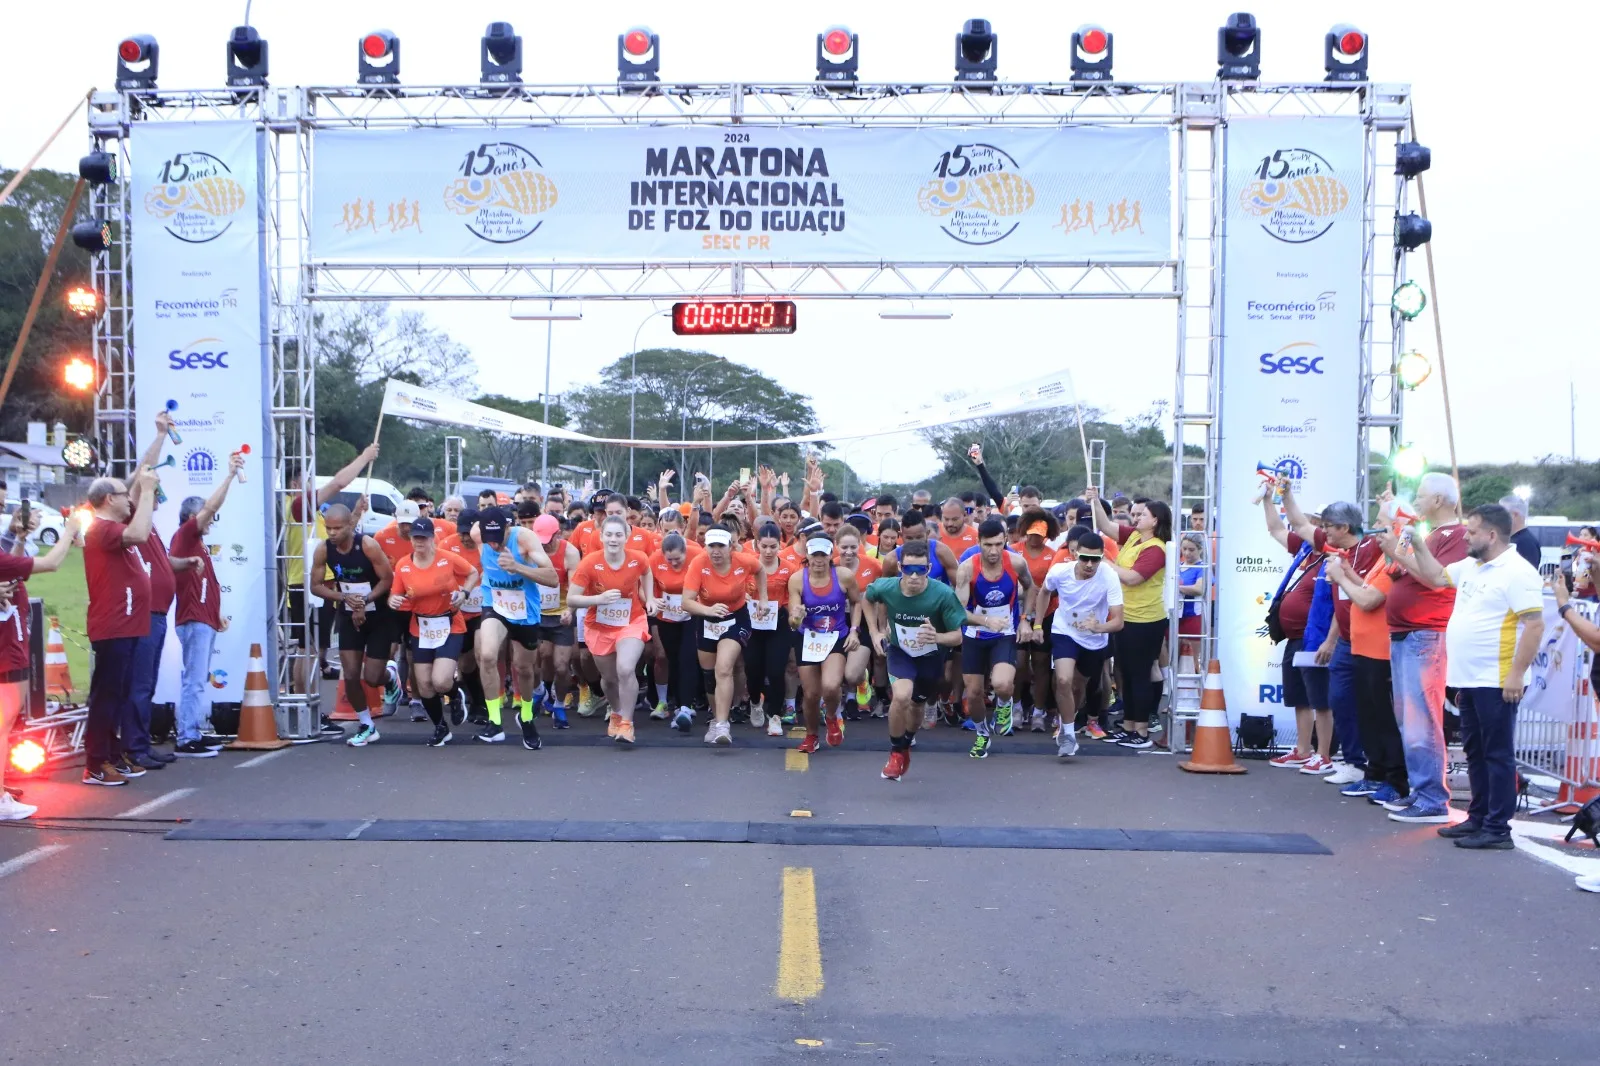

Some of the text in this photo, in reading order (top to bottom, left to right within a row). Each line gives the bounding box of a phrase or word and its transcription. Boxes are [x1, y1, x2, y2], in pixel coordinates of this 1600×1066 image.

[724, 133, 750, 143] 2024
[157, 153, 192, 183] 15
[458, 144, 497, 177] 15
[493, 157, 527, 175] anos
[645, 146, 829, 179] MARATONA
[932, 144, 973, 178] 15
[969, 158, 1004, 176] anos
[1254, 149, 1292, 180] 15
[188, 165, 217, 181] anos
[1287, 163, 1319, 179] anos
[630, 181, 845, 208] INTERNACIONAL
[628, 209, 846, 236] DE FOZ DO IGUAÇU
[703, 235, 770, 250] SESC PR
[155, 298, 238, 310] Fecomércio PR
[1247, 301, 1336, 312] Fecomércio PR
[683, 303, 792, 328] 00:00:01
[168, 350, 229, 370] Sesc
[1259, 353, 1324, 374] Sesc
[174, 419, 212, 428] Sindilojas
[1262, 425, 1303, 434] Sindilojas
[1236, 555, 1263, 565] urbia
[1235, 566, 1284, 574] CATARATAS
[463, 596, 484, 606] 287
[540, 593, 558, 602] 197
[498, 600, 525, 612] 4164
[601, 607, 629, 618] 4590
[423, 628, 449, 640] 4685
[707, 623, 726, 635] 459
